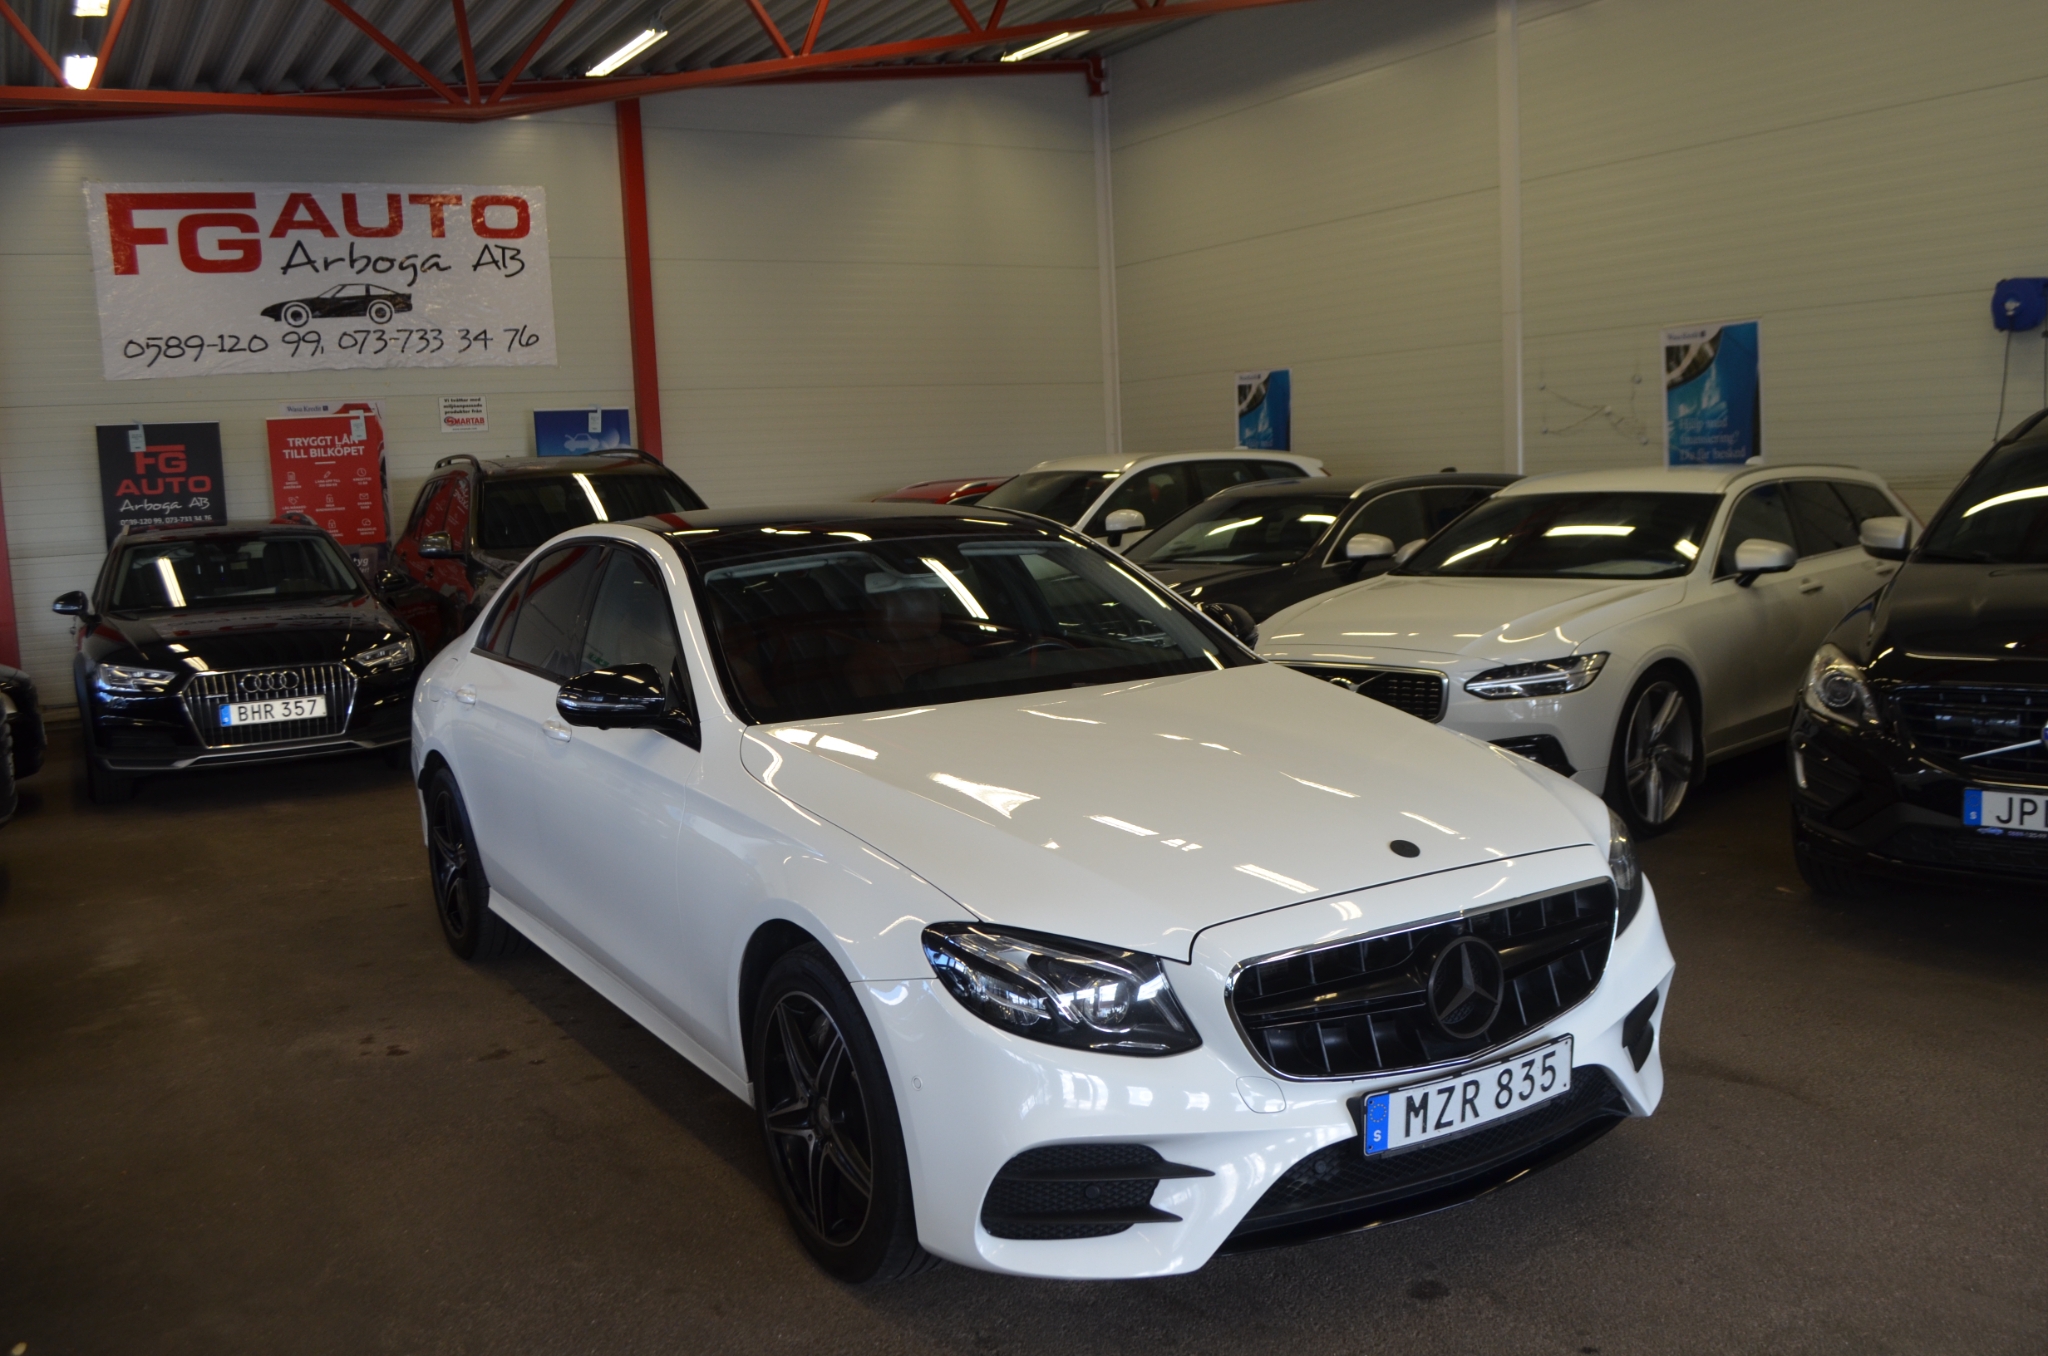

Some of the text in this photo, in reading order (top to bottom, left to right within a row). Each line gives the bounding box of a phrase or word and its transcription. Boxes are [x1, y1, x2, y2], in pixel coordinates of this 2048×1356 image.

[105, 192, 531, 275] FG AUTO
[281, 240, 526, 287] Arboga AB
[123, 333, 269, 367] 0589-120
[338, 328, 444, 354] 073-733
[458, 328, 493, 352] 34
[503, 324, 540, 350] 76
[282, 445, 365, 459] TILL BILKÖPET
[286, 436, 332, 447] TRYGGT
[136, 445, 187, 474] FG
[116, 476, 212, 496] AUTO
[119, 497, 210, 514] Arboga AB
[238, 699, 317, 722] BHR 357
[1996, 797, 2048, 827] JP
[1404, 1050, 1556, 1138] MZR 835
[1373, 1129, 1382, 1142] S
